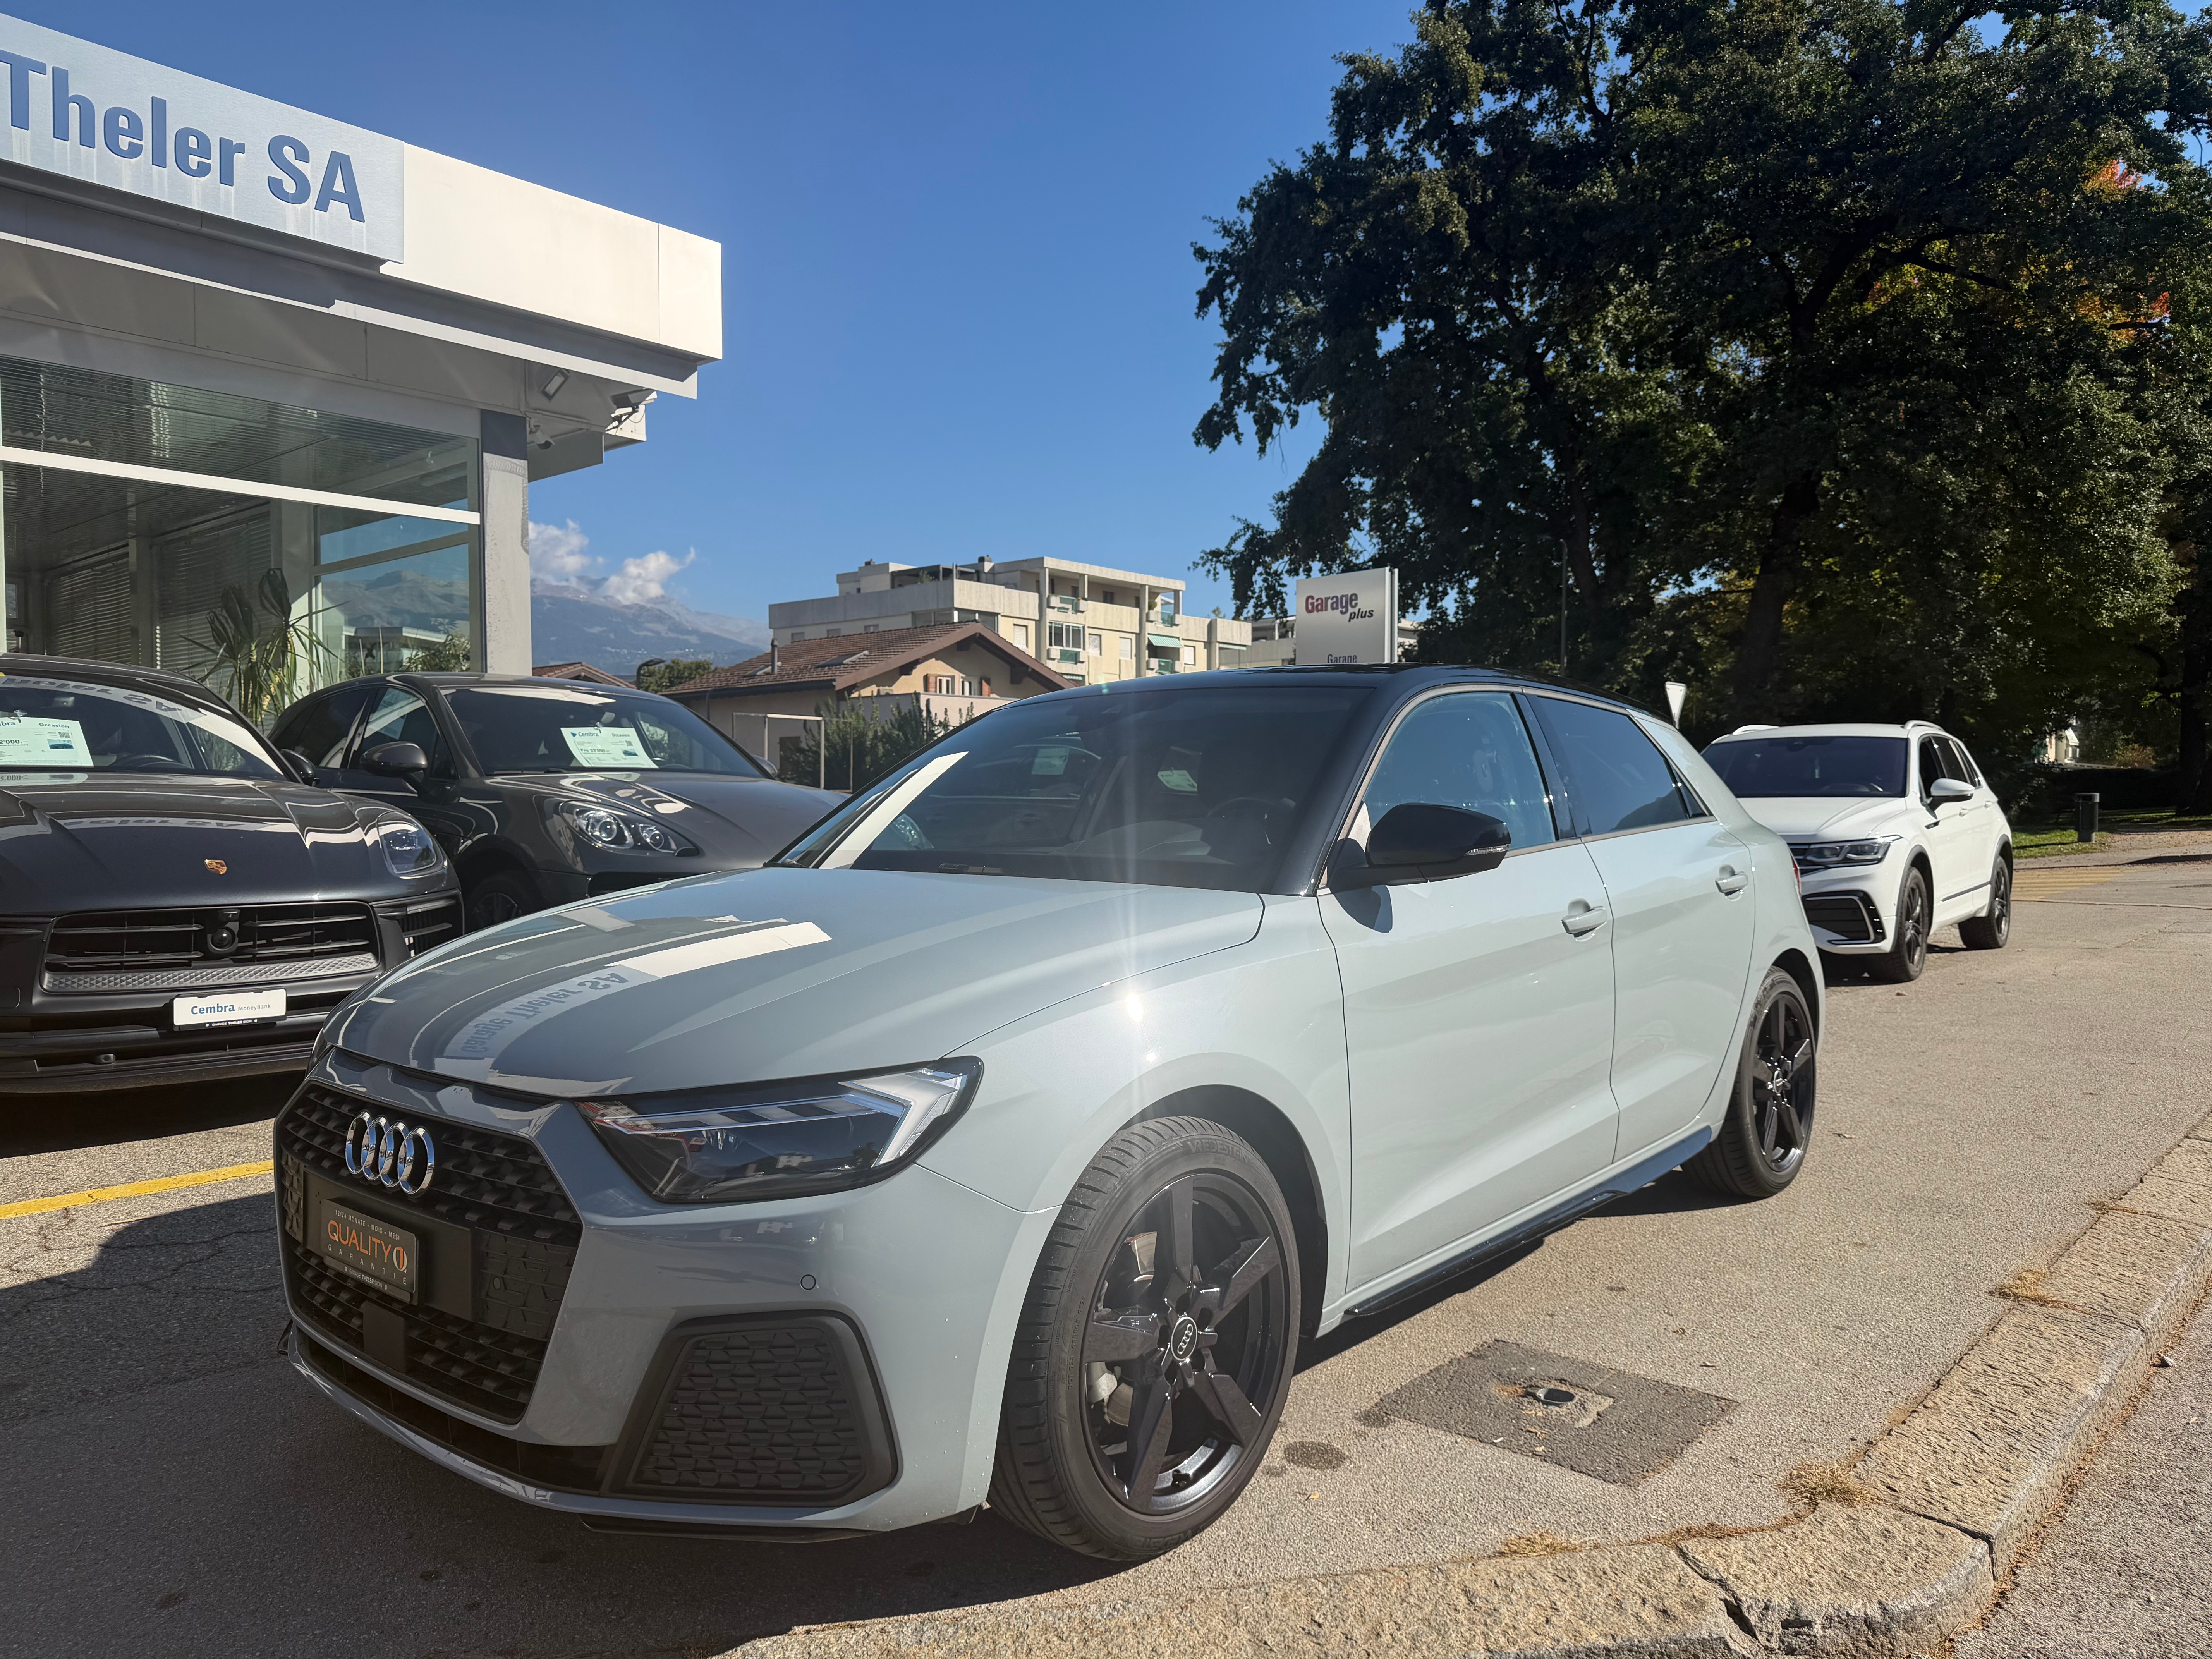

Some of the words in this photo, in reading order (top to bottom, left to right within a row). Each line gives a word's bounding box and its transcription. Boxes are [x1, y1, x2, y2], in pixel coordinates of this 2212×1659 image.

[0, 49, 246, 188] Theler
[267, 134, 365, 223] SA
[1305, 592, 1358, 615] Garage
[1348, 608, 1374, 622] plus
[191, 1003, 235, 1015] Cembra
[335, 1209, 347, 1219] 12/24
[348, 1215, 365, 1227] MONATE
[371, 1224, 383, 1234] MOIS
[388, 1231, 400, 1241] MESI
[328, 1244, 406, 1285] GARANTIE
